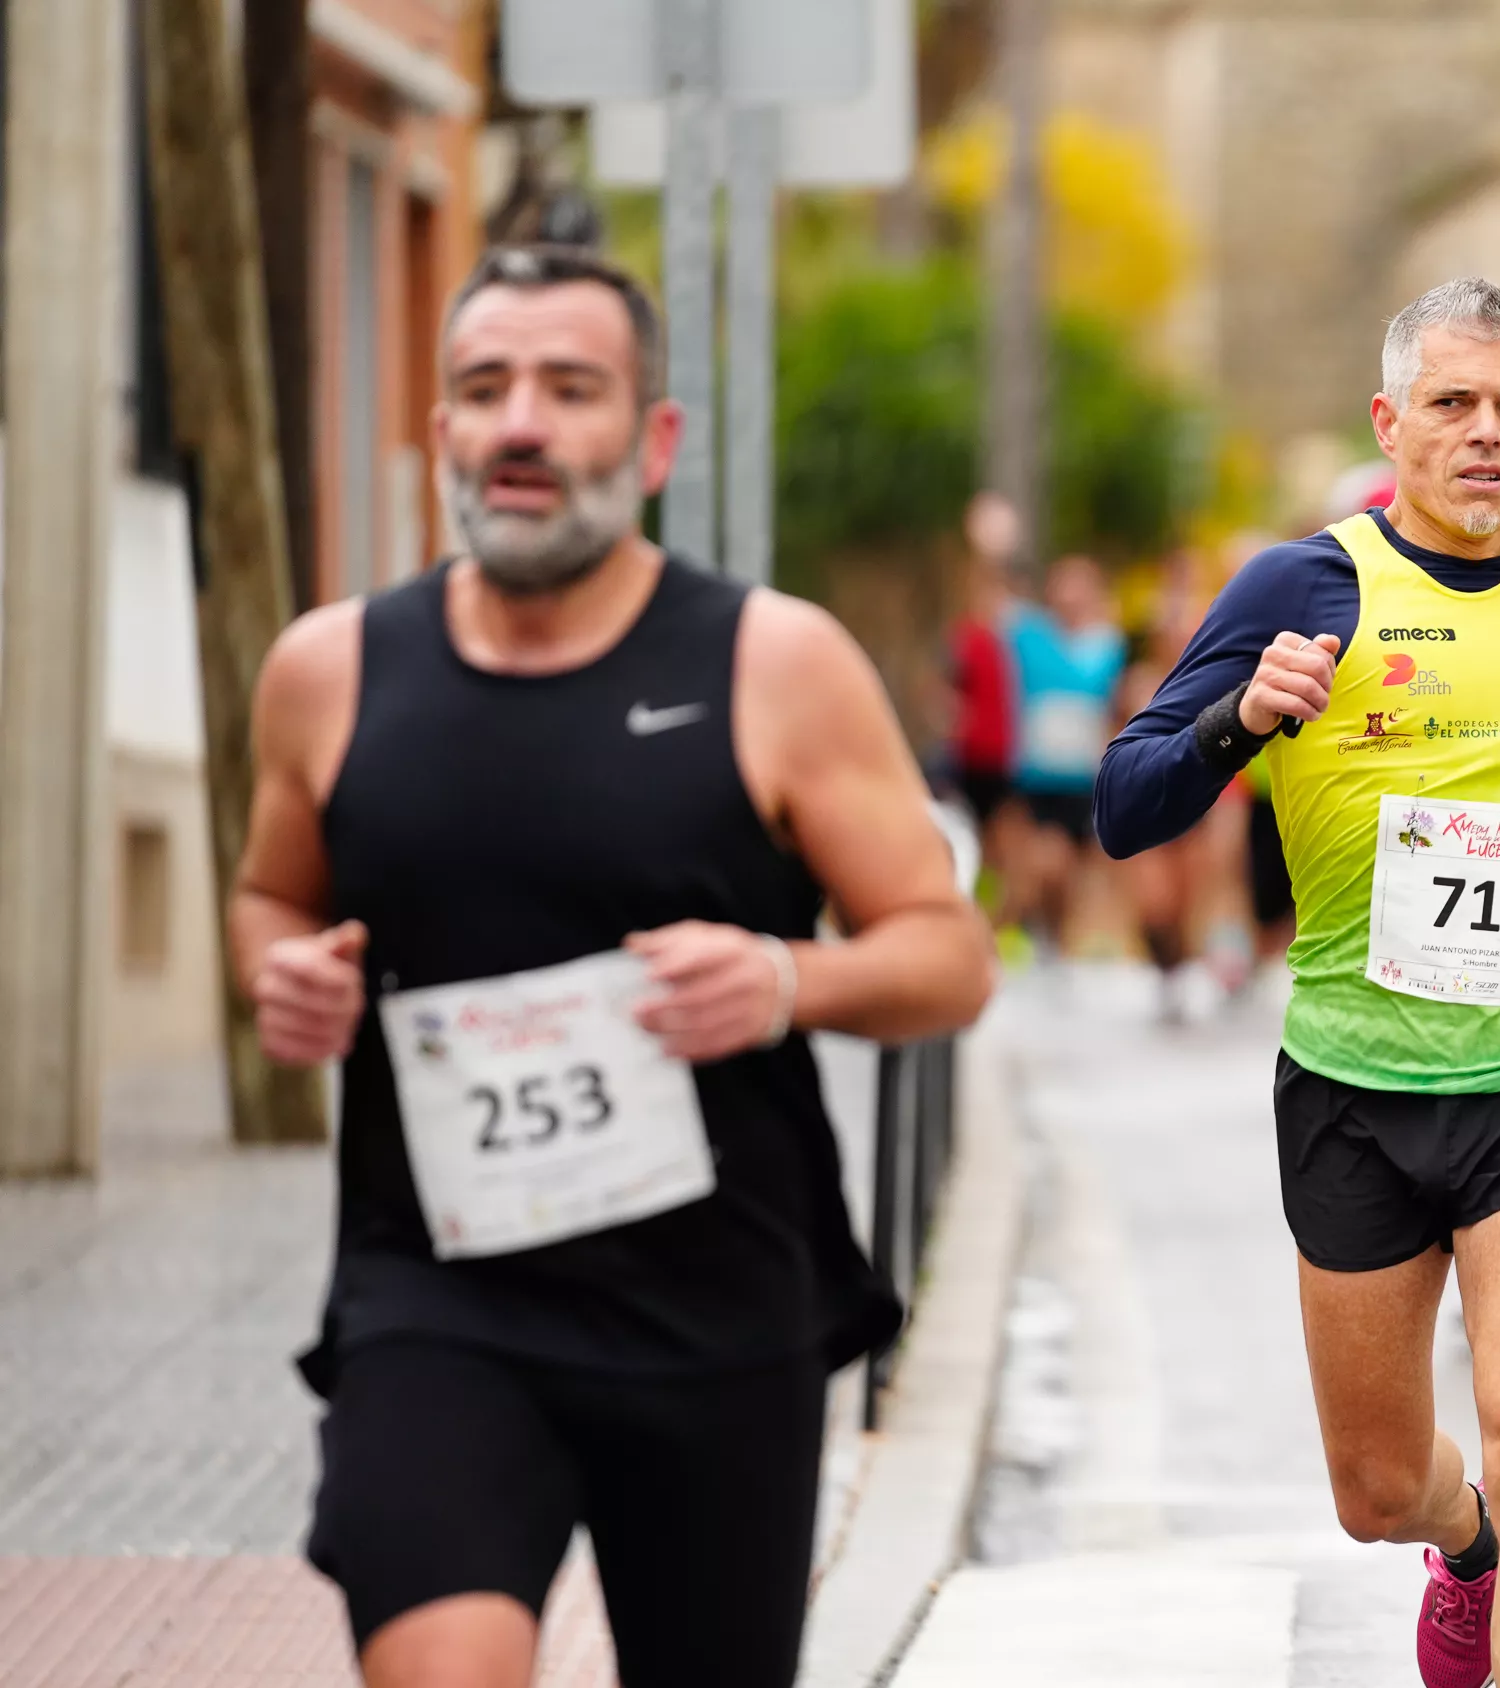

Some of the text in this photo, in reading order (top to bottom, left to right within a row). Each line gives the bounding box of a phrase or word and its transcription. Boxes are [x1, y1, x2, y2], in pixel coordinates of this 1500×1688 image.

[1378, 627, 1439, 642] emec
[1417, 670, 1438, 684] DS
[1407, 682, 1452, 697] Smith
[1447, 720, 1500, 728] BODEGAS
[1440, 729, 1454, 738] EL
[1337, 740, 1370, 756] Castillo
[1370, 737, 1413, 753] Moriles
[1420, 944, 1440, 953] JUAN
[1442, 946, 1477, 956] ANTONIO
[1462, 959, 1498, 968] S-Hombre
[465, 1064, 616, 1156] 253
